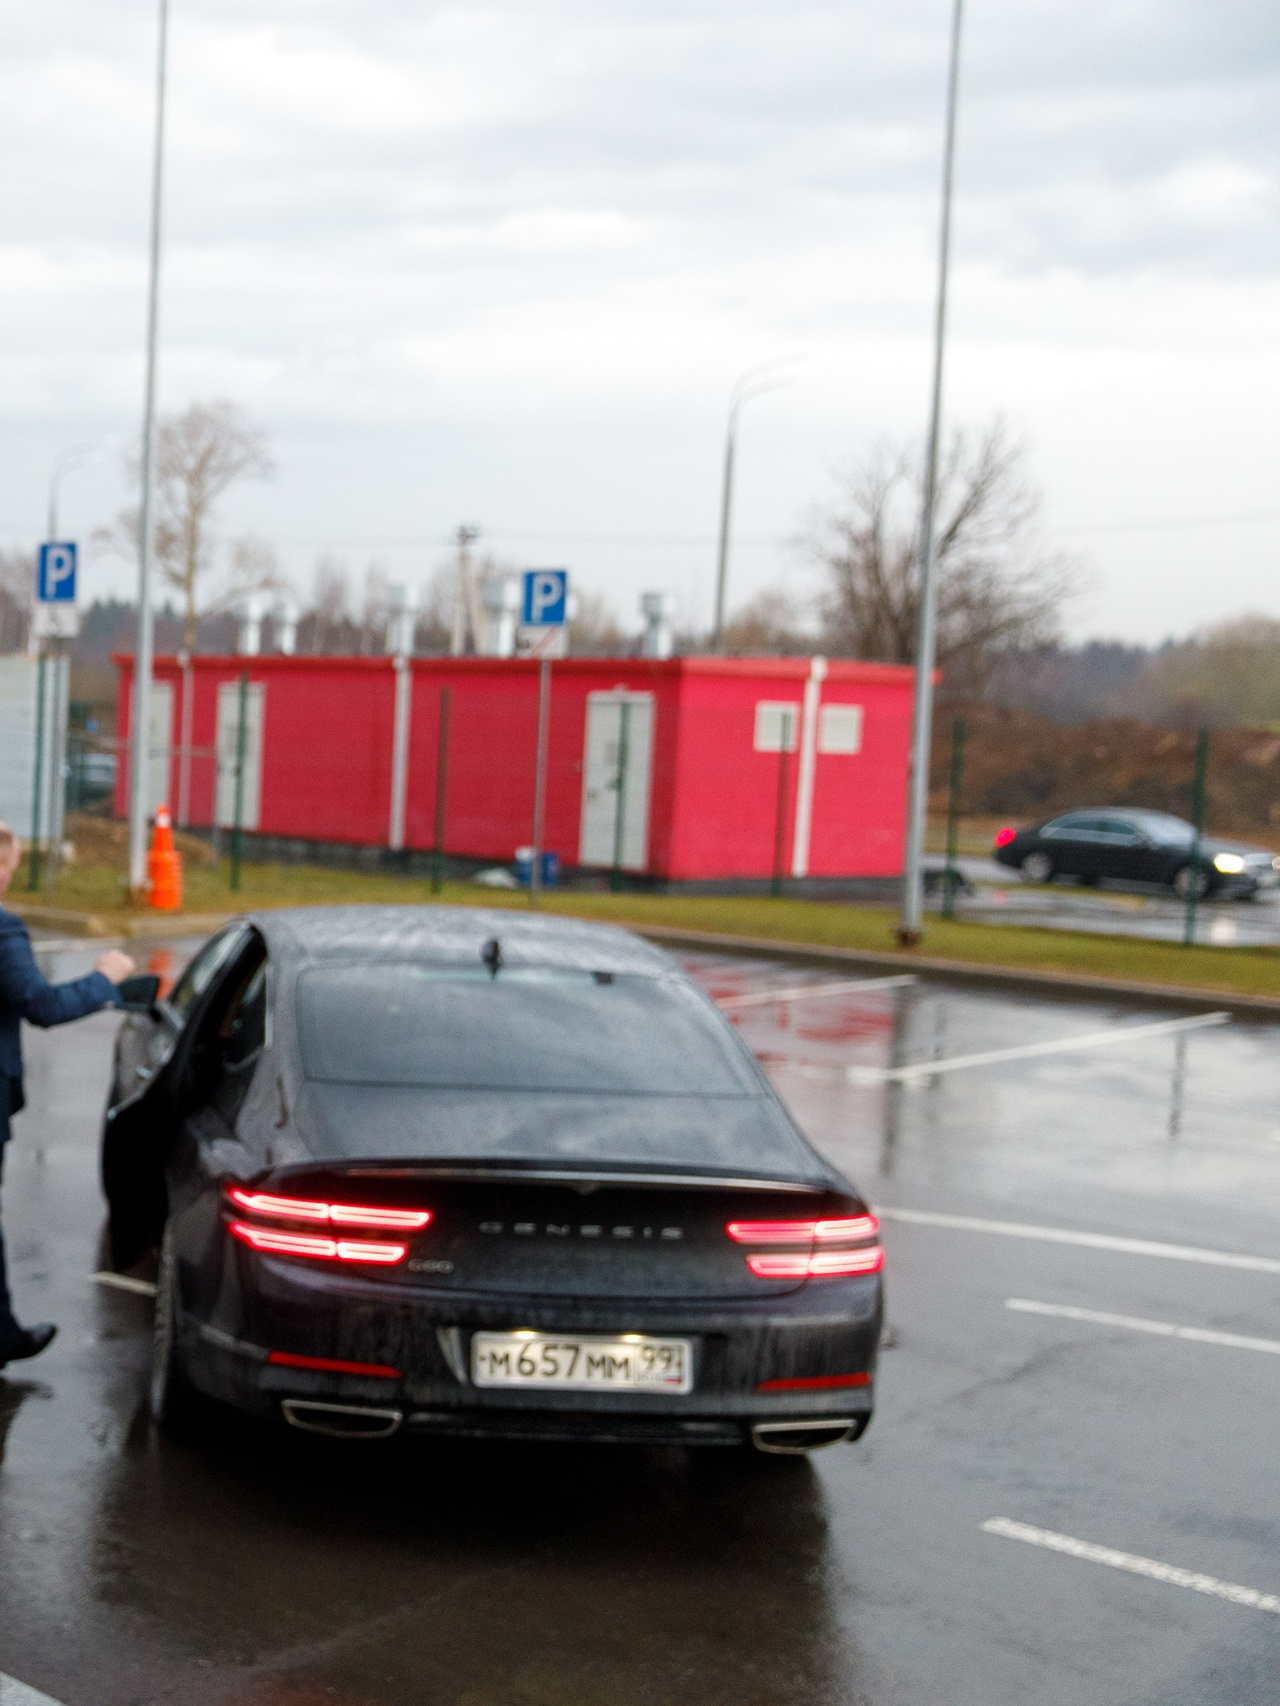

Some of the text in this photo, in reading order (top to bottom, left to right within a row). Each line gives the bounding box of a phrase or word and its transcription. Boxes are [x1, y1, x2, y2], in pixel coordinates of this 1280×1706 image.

[46, 547, 73, 600] P
[531, 574, 562, 623] P
[478, 1221, 685, 1241] GENESIS
